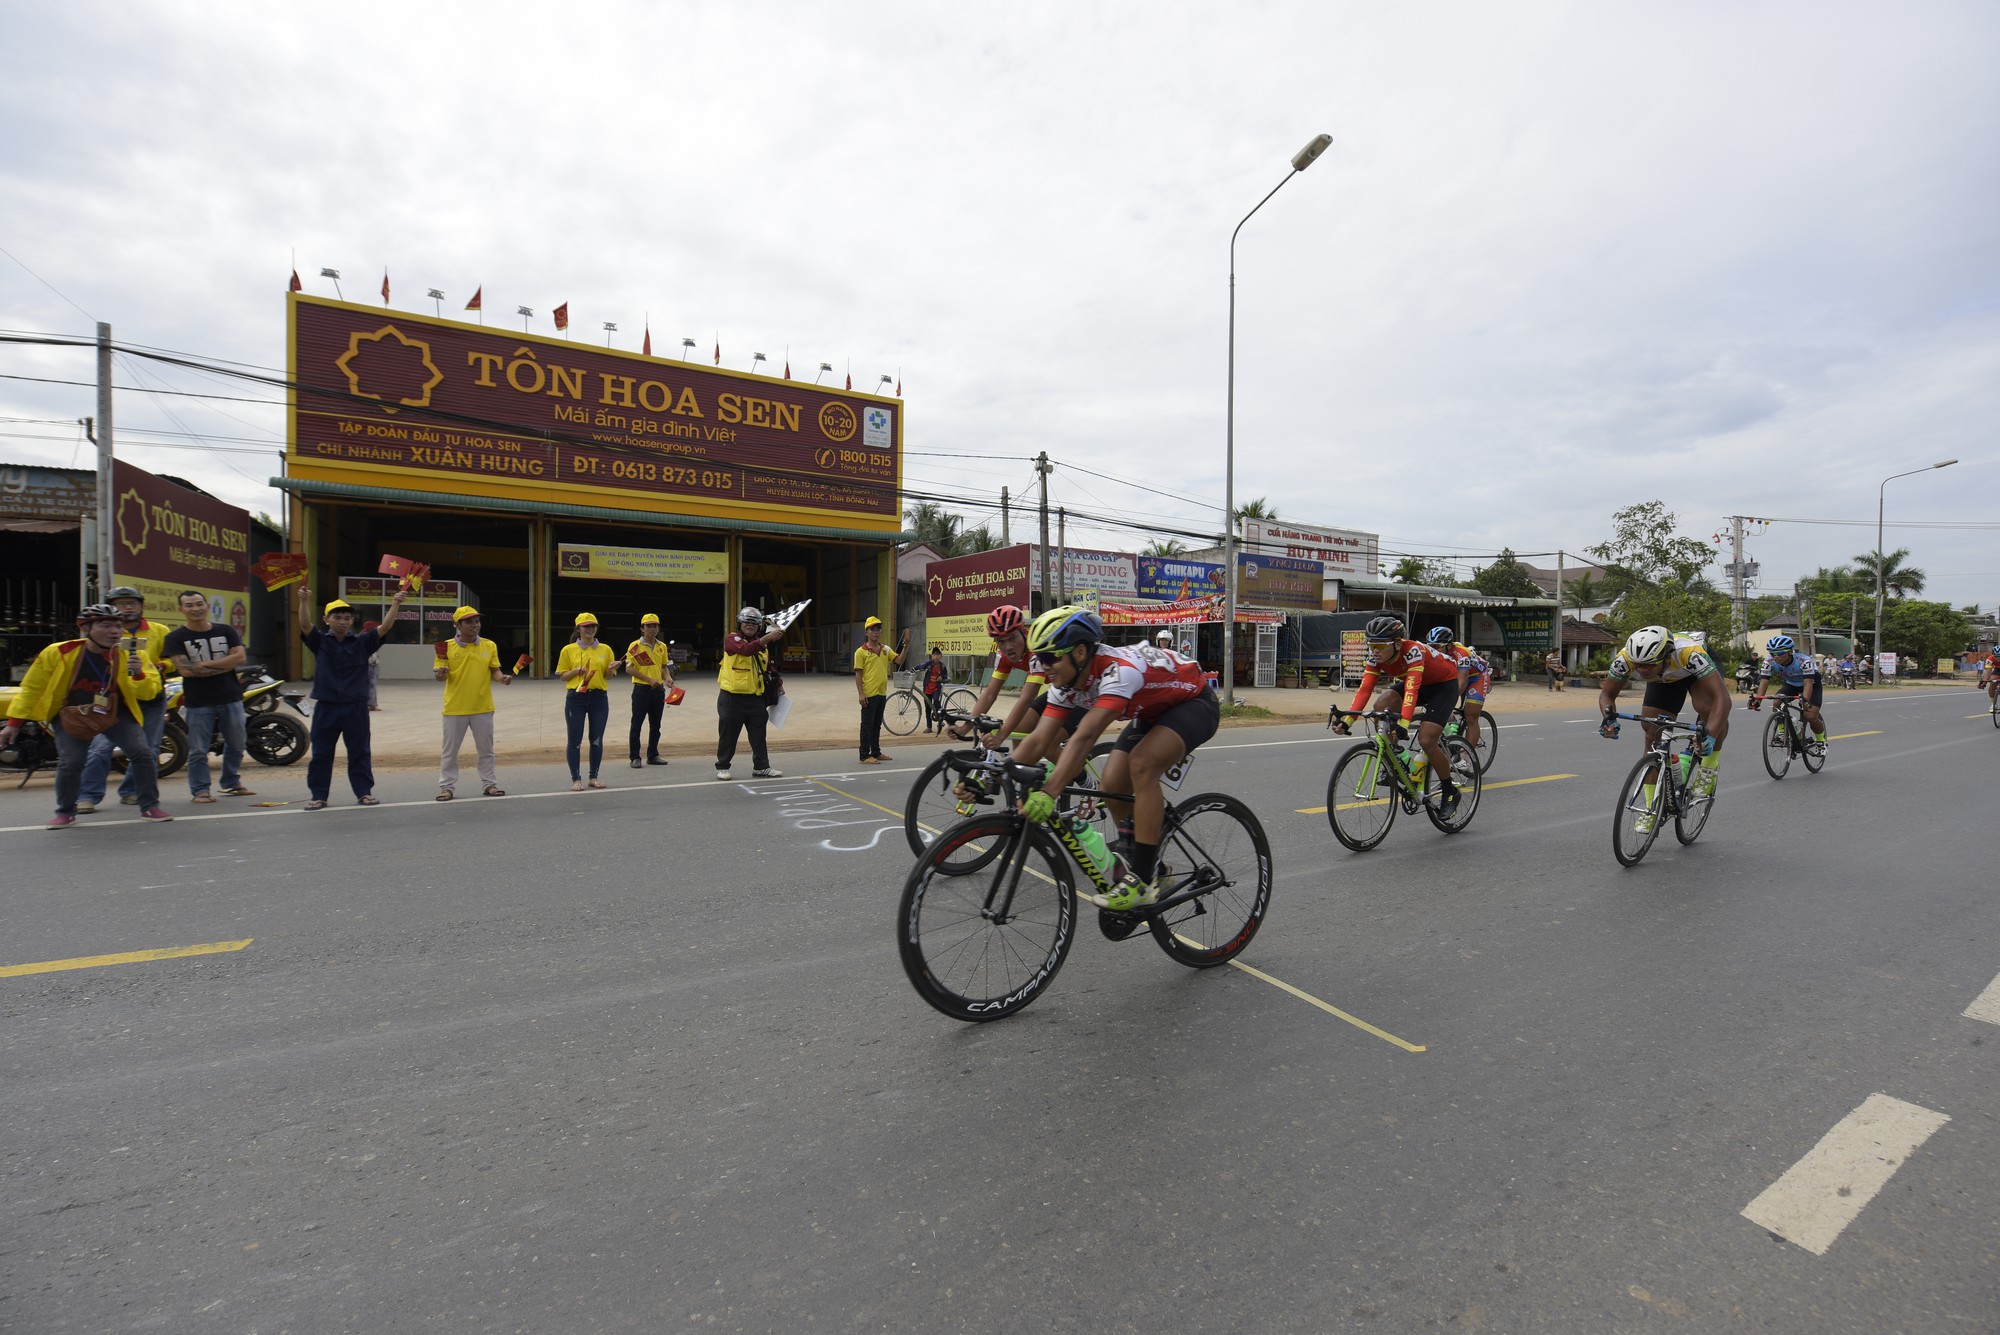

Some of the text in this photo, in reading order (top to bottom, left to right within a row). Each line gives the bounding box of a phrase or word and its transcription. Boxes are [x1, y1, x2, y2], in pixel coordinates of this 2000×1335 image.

[468, 346, 803, 433] TÔN HOA SEN
[555, 403, 737, 447] Mái ấm gia đình Việt
[823, 415, 852, 429] 10-20
[338, 422, 521, 452] TẬP ĐOÀN ĐẦU TƯ HOA SEN
[829, 426, 847, 437] NĂM
[592, 432, 706, 456] www.hoasengroup.vn
[317, 443, 544, 475] CHI NHÁNH XUÂN HƯNG
[839, 450, 892, 467] 1800 1515
[573, 455, 732, 489] ĐT: 0613 873 015
[152, 500, 247, 553] TÔN HOA SEN
[618, 551, 630, 560] ĐẠP
[1082, 553, 1100, 561] CAO
[1287, 544, 1350, 563] HUY MINH
[946, 574, 963, 590] ỐNG
[986, 570, 1005, 584] HOA
[1007, 567, 1026, 580] SEN
[1087, 563, 1128, 578] DUNG
[1164, 563, 1205, 579] CHIKAPU
[1525, 620, 1549, 630] LINH
[950, 641, 961, 651] 873
[962, 641, 972, 651] 015
[1406, 648, 1421, 661] 82
[1686, 654, 1704, 670] 47
[1613, 659, 1627, 673] 47
[966, 880, 1071, 1012] CAMPAGNOLO
